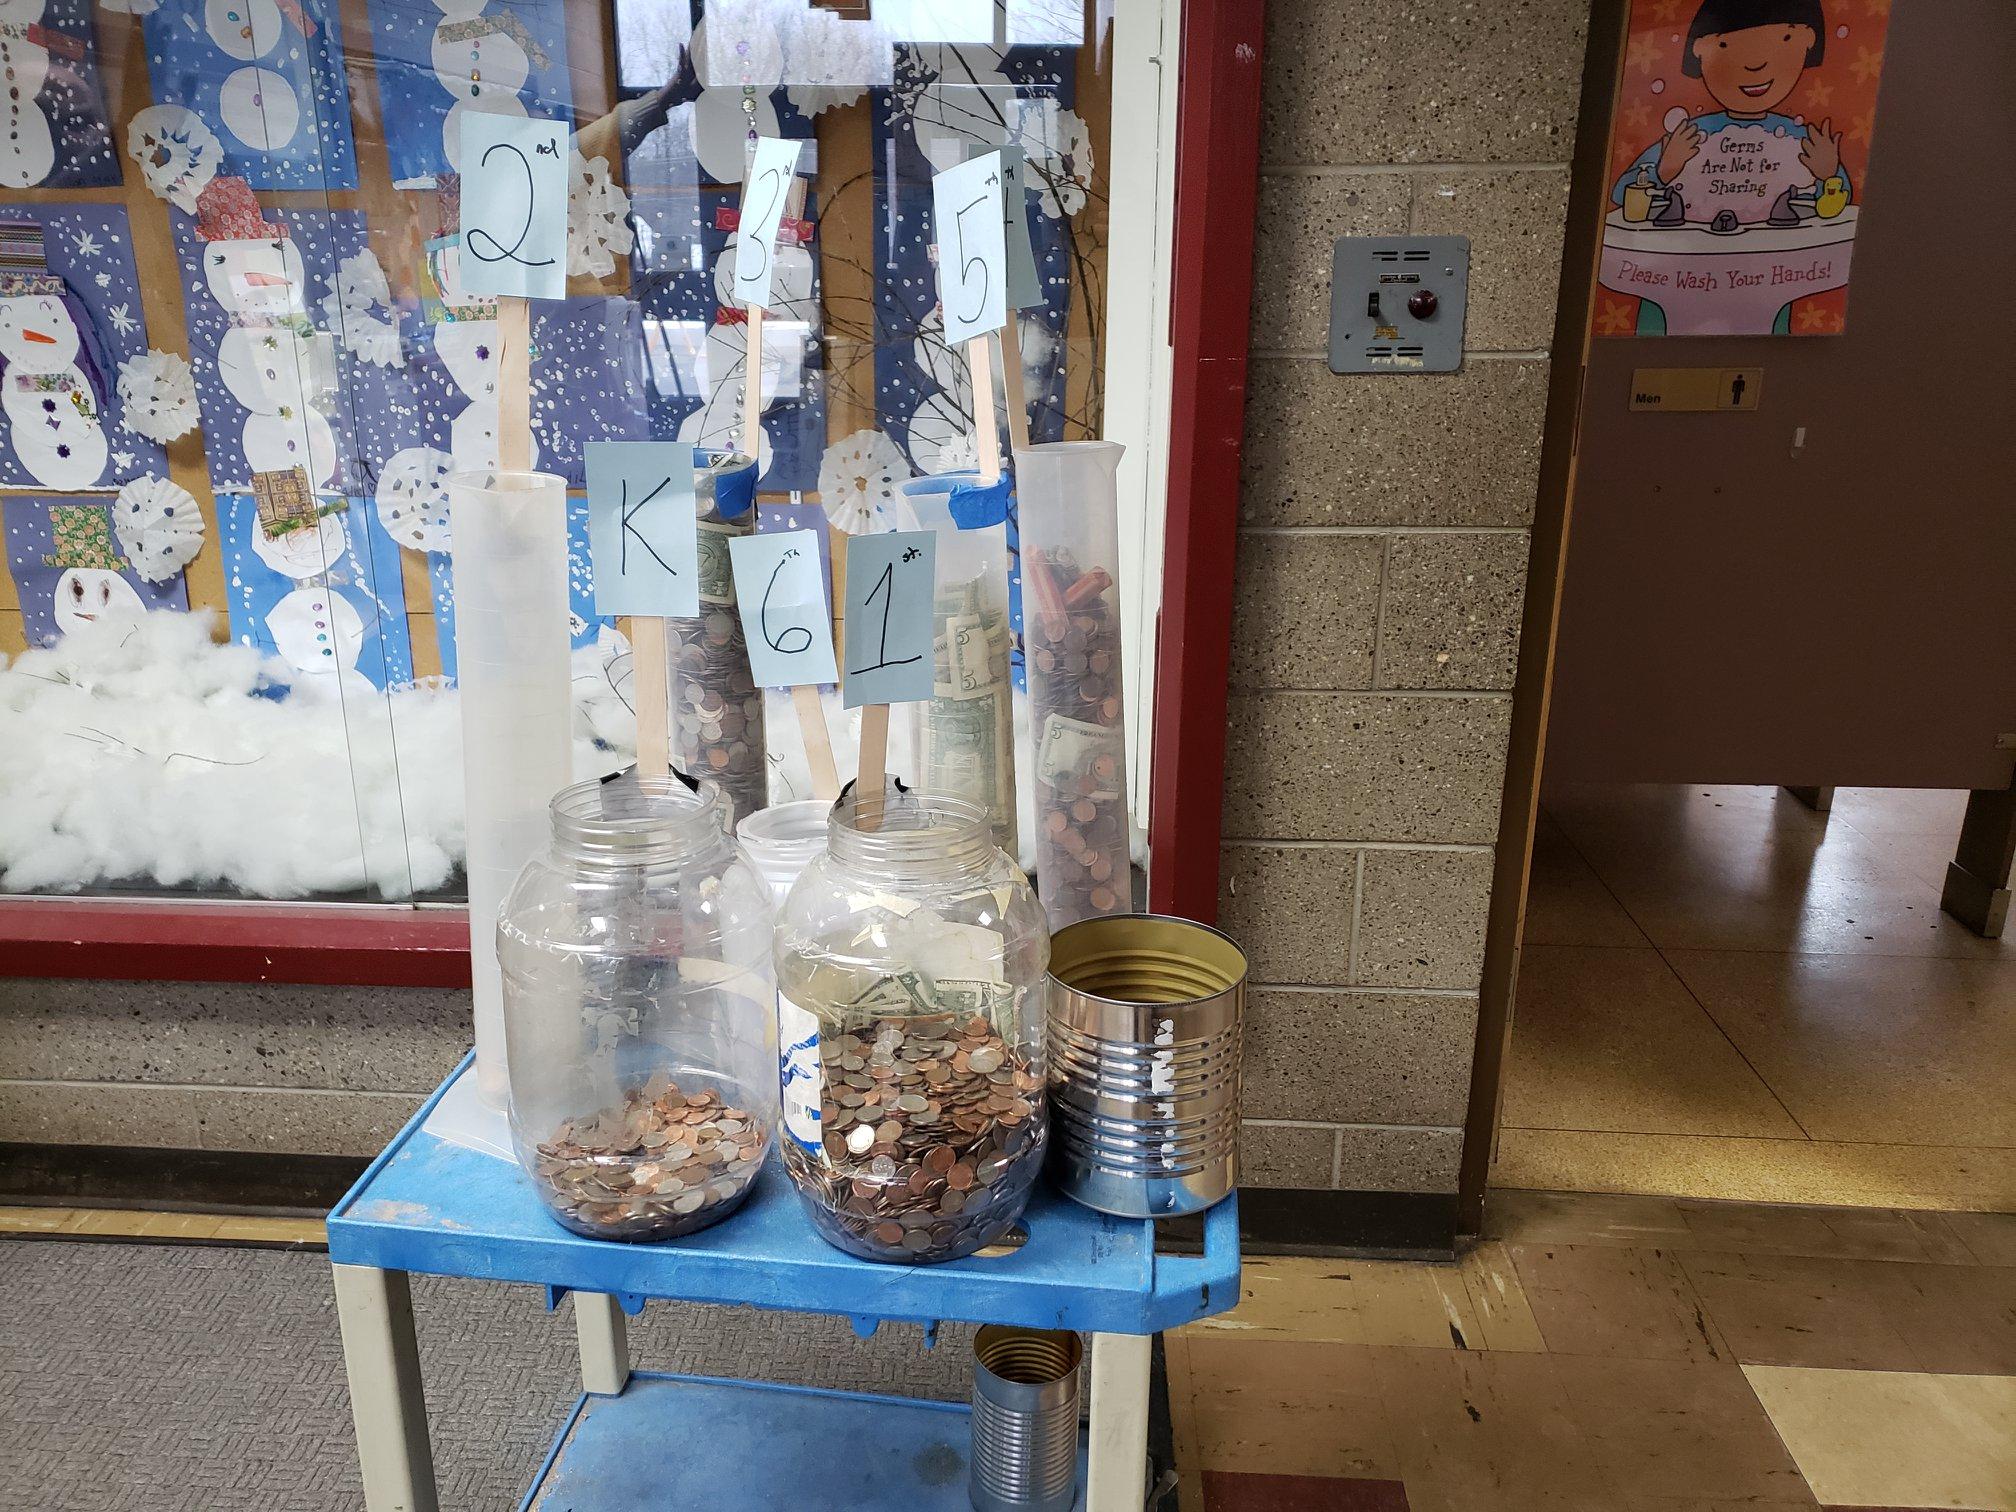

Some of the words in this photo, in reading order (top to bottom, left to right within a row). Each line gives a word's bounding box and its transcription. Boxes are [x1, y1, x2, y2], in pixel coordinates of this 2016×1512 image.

[1719, 136, 1764, 154] Germs
[1700, 158, 1726, 174] Are
[1729, 157, 1753, 173] Not
[1759, 157, 1781, 173] for
[1708, 179, 1768, 197] Sharing
[1617, 260, 1669, 286] Please
[1676, 270, 1718, 291] Wash
[1726, 270, 1764, 289] Your
[1771, 261, 1832, 284] Hands!
[1635, 393, 1661, 404] Men
[621, 476, 678, 577] K
